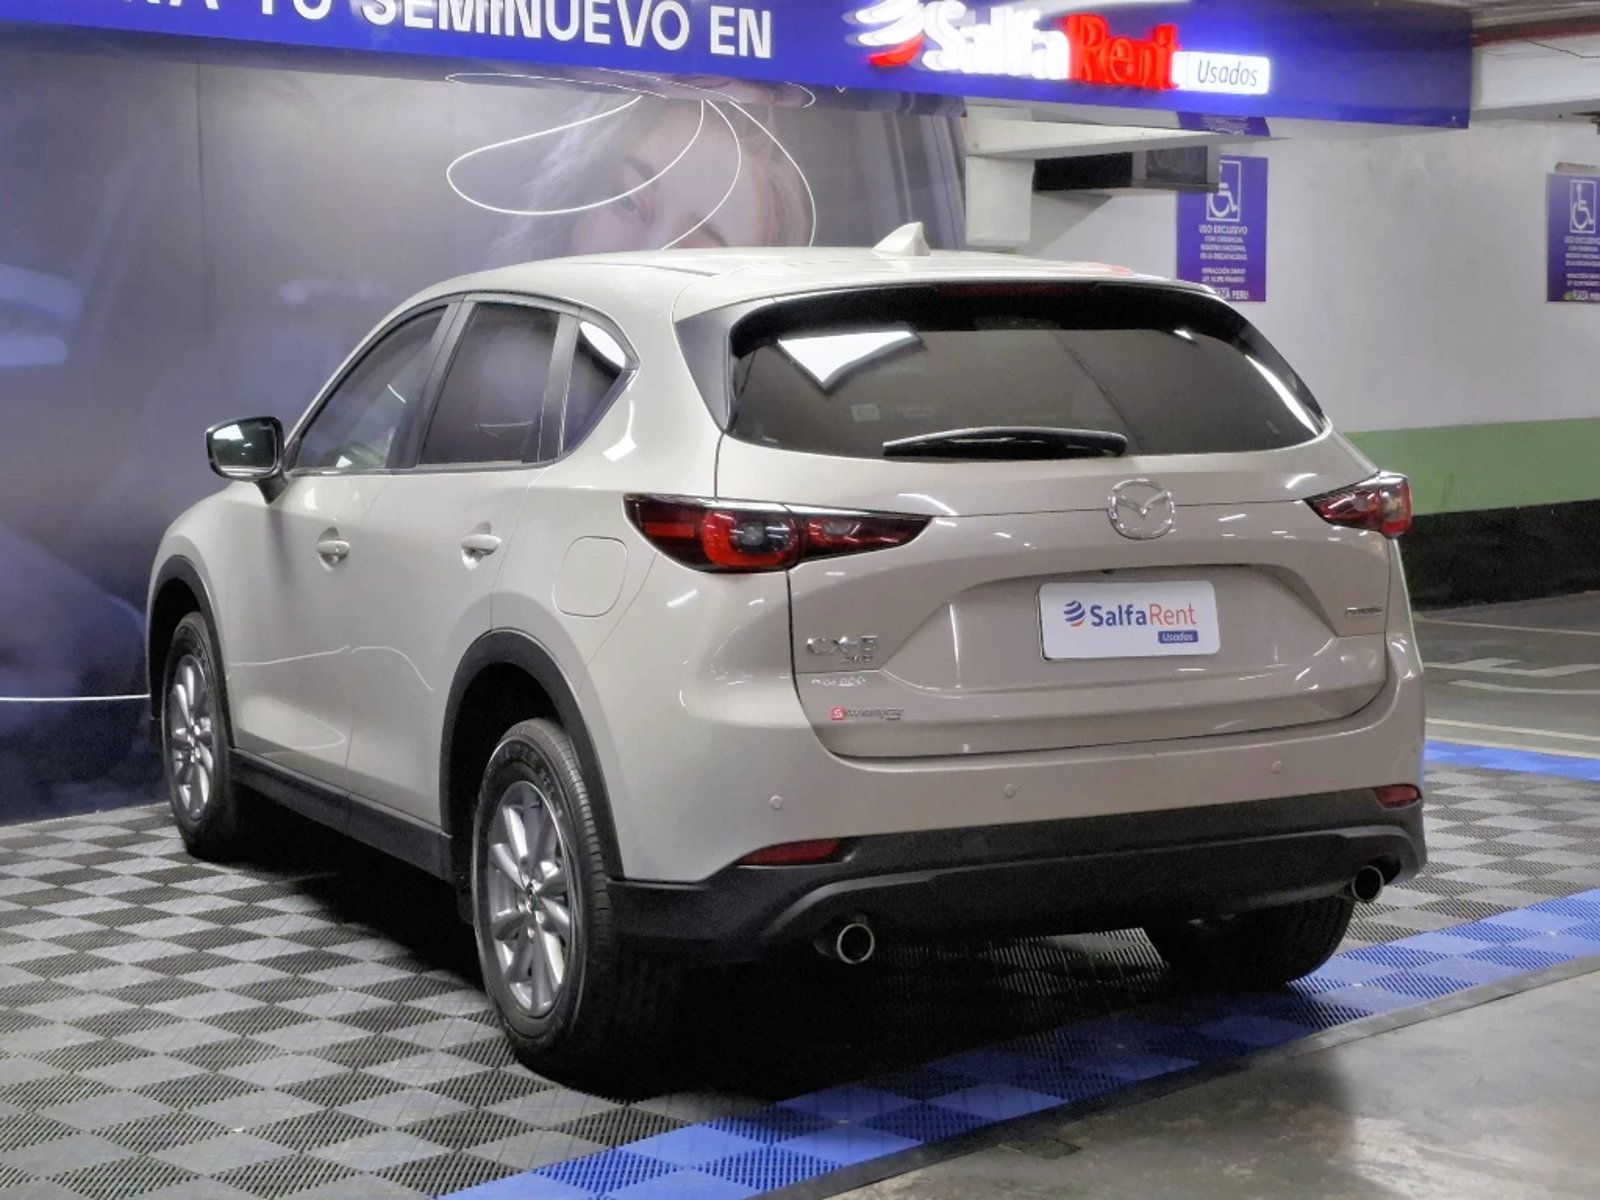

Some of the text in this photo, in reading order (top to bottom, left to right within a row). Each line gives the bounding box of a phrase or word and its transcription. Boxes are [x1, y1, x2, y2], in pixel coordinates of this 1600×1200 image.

[710, 5, 772, 59] EN
[1197, 59, 1259, 87] Usados
[1090, 603, 1197, 627] SalfaRent
[1162, 633, 1193, 642] Usados
